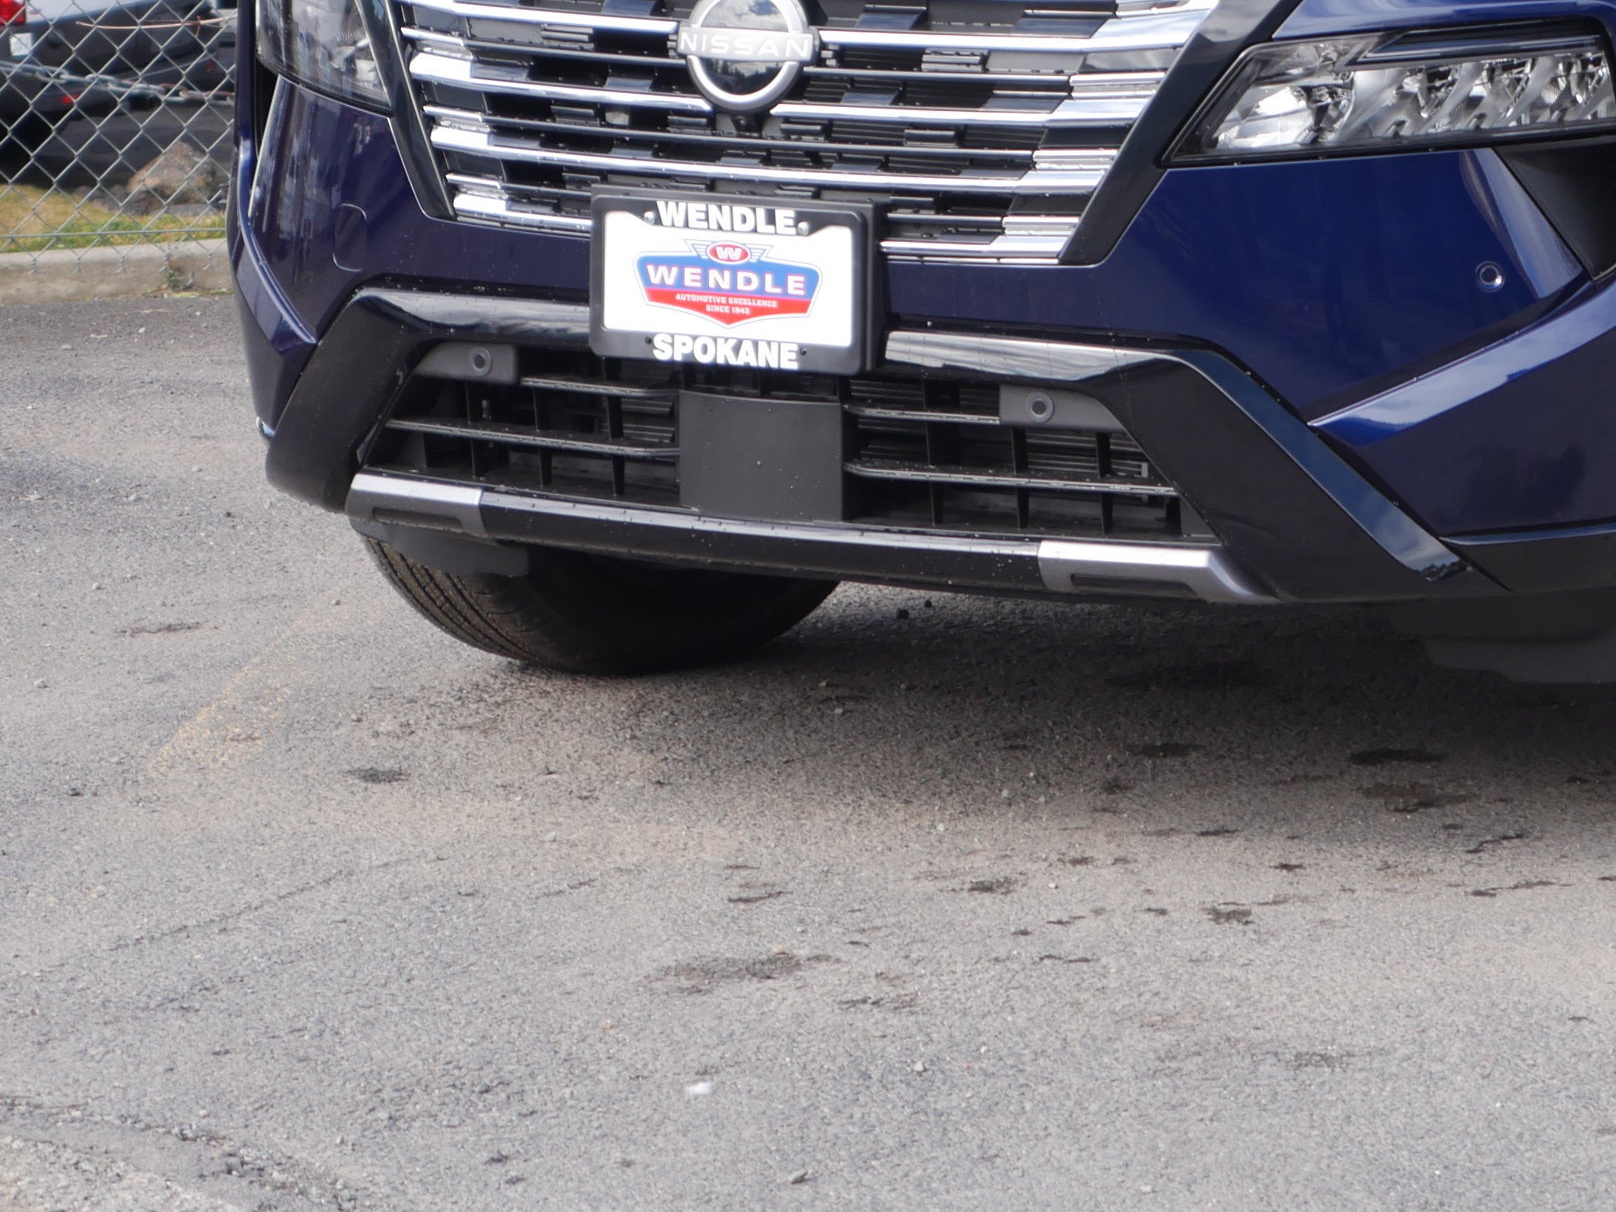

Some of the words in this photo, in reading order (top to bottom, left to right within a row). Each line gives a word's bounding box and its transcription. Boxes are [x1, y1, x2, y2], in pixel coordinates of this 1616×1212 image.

[680, 30, 810, 58] NISSAN
[656, 199, 797, 236] WENDLE
[646, 263, 807, 296] WENDLE
[675, 292, 727, 305] AUTOMOTIVE
[728, 296, 778, 308] EXCELLENCE
[705, 303, 731, 314] SINCE
[652, 332, 799, 370] SPOKANE
